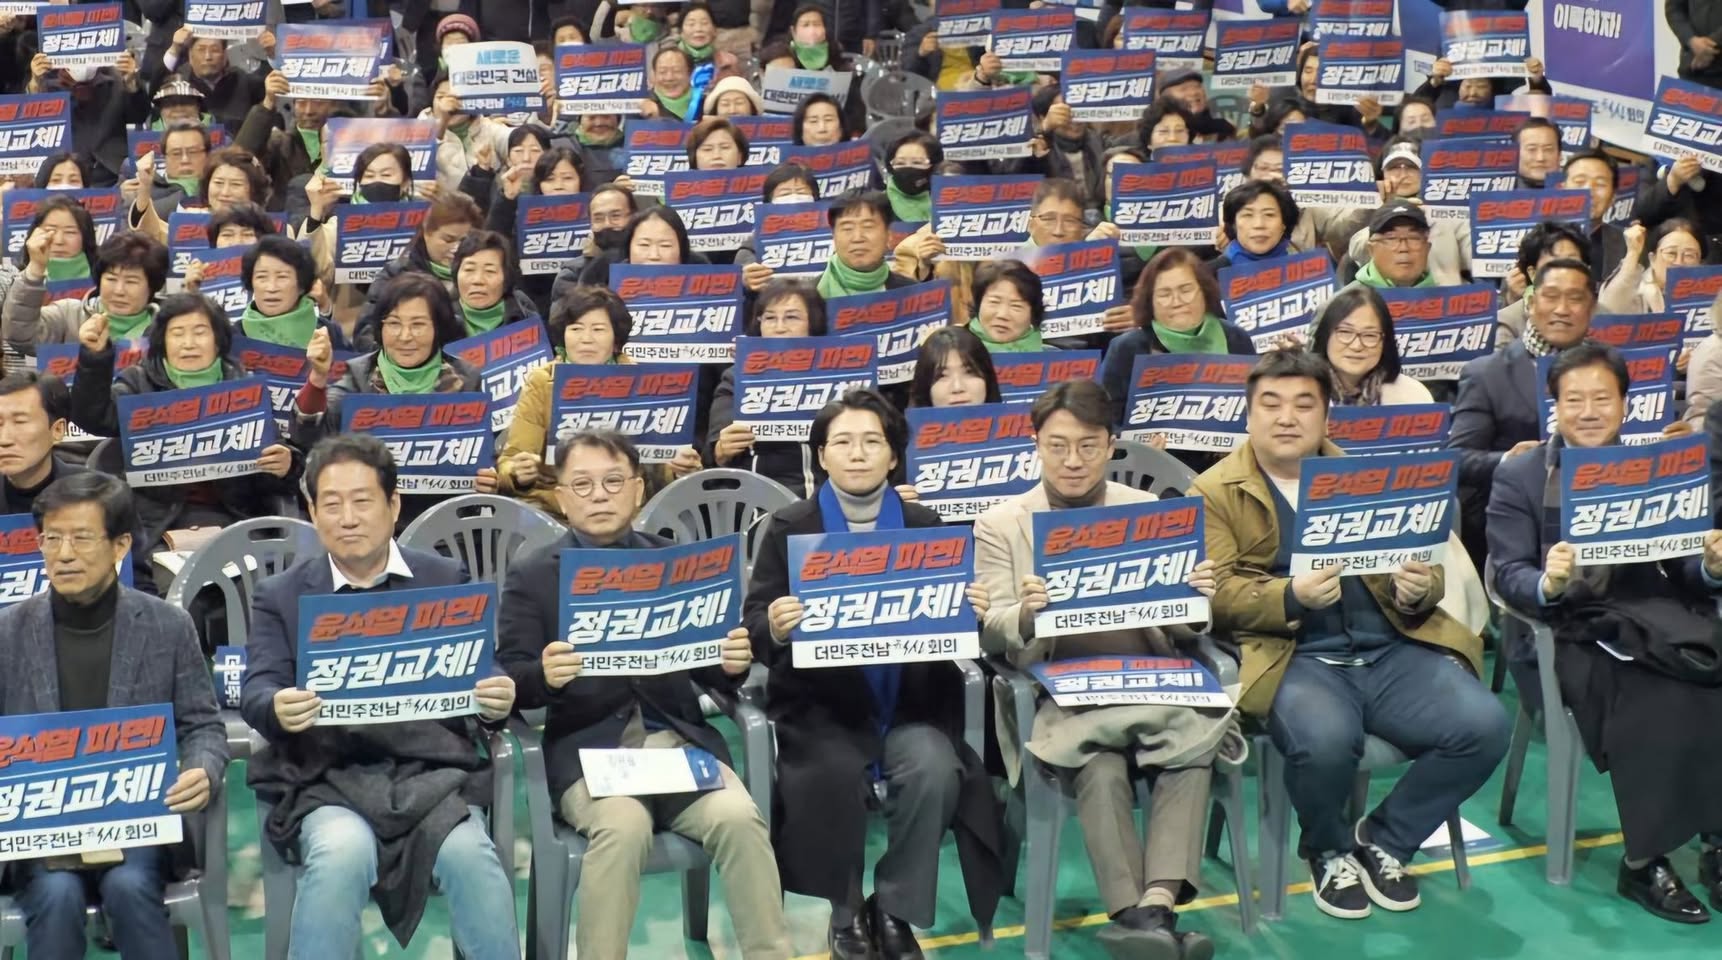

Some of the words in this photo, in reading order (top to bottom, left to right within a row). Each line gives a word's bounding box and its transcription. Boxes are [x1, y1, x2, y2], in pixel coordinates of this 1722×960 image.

[42, 28, 119, 52] 정권교체!
[995, 34, 1072, 55] 정권교체!
[1447, 40, 1525, 61] 정권교체!
[282, 57, 374, 78] 정권교체!
[1217, 46, 1293, 72] 정권교체!
[559, 72, 642, 97] 정권교체!
[1322, 63, 1400, 86] 정권교체!
[1066, 77, 1151, 104] 정권교체!
[0, 125, 62, 150] 교체!
[941, 115, 1025, 144] 정권교체!
[1650, 111, 1722, 147] 정권교
[627, 155, 689, 176] 정권교
[1287, 161, 1375, 184] 정권교체!
[676, 203, 755, 229] 정권교체
[1115, 195, 1214, 225] 정권교체!
[937, 210, 1031, 238] 정권교체
[341, 239, 405, 263] 정권교
[524, 234, 590, 254] 정권교
[762, 241, 834, 268] 정권교
[1042, 276, 1115, 311] 권교체!
[628, 306, 736, 337] 정권교체!
[555, 405, 688, 438] 정권교체!
[1129, 394, 1246, 425] 정권교체!
[131, 419, 265, 467] 정권교체!
[384, 436, 485, 466] 권교체!
[915, 451, 1042, 494] 정권교체
[1301, 500, 1448, 547] 정권교체!
[1569, 484, 1708, 536] 정권교체!
[1045, 550, 1197, 604] 정권교체!
[568, 588, 731, 645] 정권교체!
[800, 582, 966, 633] 정권교체!
[1055, 609, 1126, 630] 더민주전남
[1161, 603, 1188, 618] 회의
[581, 655, 658, 671] 더민주전남
[693, 644, 722, 661] 회의
[814, 643, 890, 661] 더민주전남
[928, 638, 957, 655] 회의
[305, 638, 485, 692] 정권교체!
[1054, 672, 1203, 692] 정권교체!
[320, 701, 400, 720] 더민주전남
[440, 694, 470, 712] 회의
[84, 715, 166, 755] 파면!
[125, 821, 158, 841] 회의
